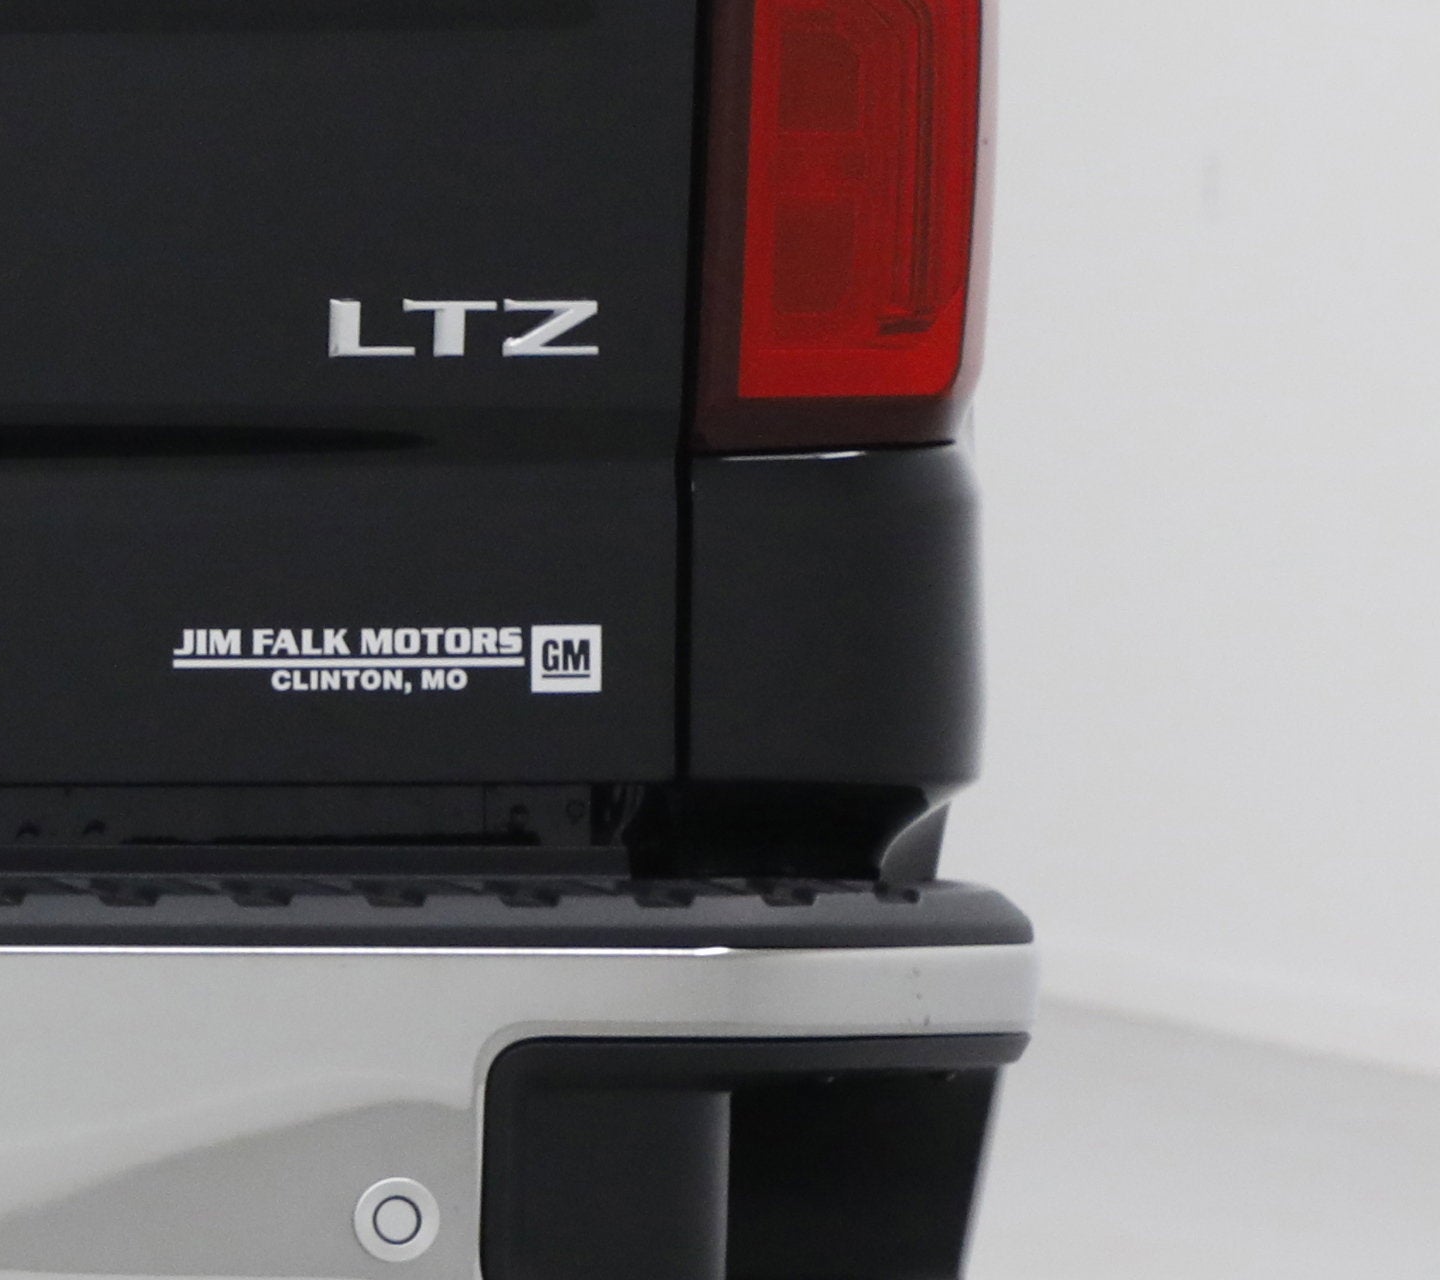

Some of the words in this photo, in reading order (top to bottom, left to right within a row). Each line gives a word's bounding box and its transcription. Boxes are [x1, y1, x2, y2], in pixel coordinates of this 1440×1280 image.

[328, 297, 600, 357] LTZ
[173, 627, 241, 657] JIM
[252, 627, 352, 657] FALK
[360, 626, 523, 656] MOTORS
[540, 638, 592, 674] GM
[270, 668, 413, 695] CLINTON,
[421, 668, 468, 691] MO
